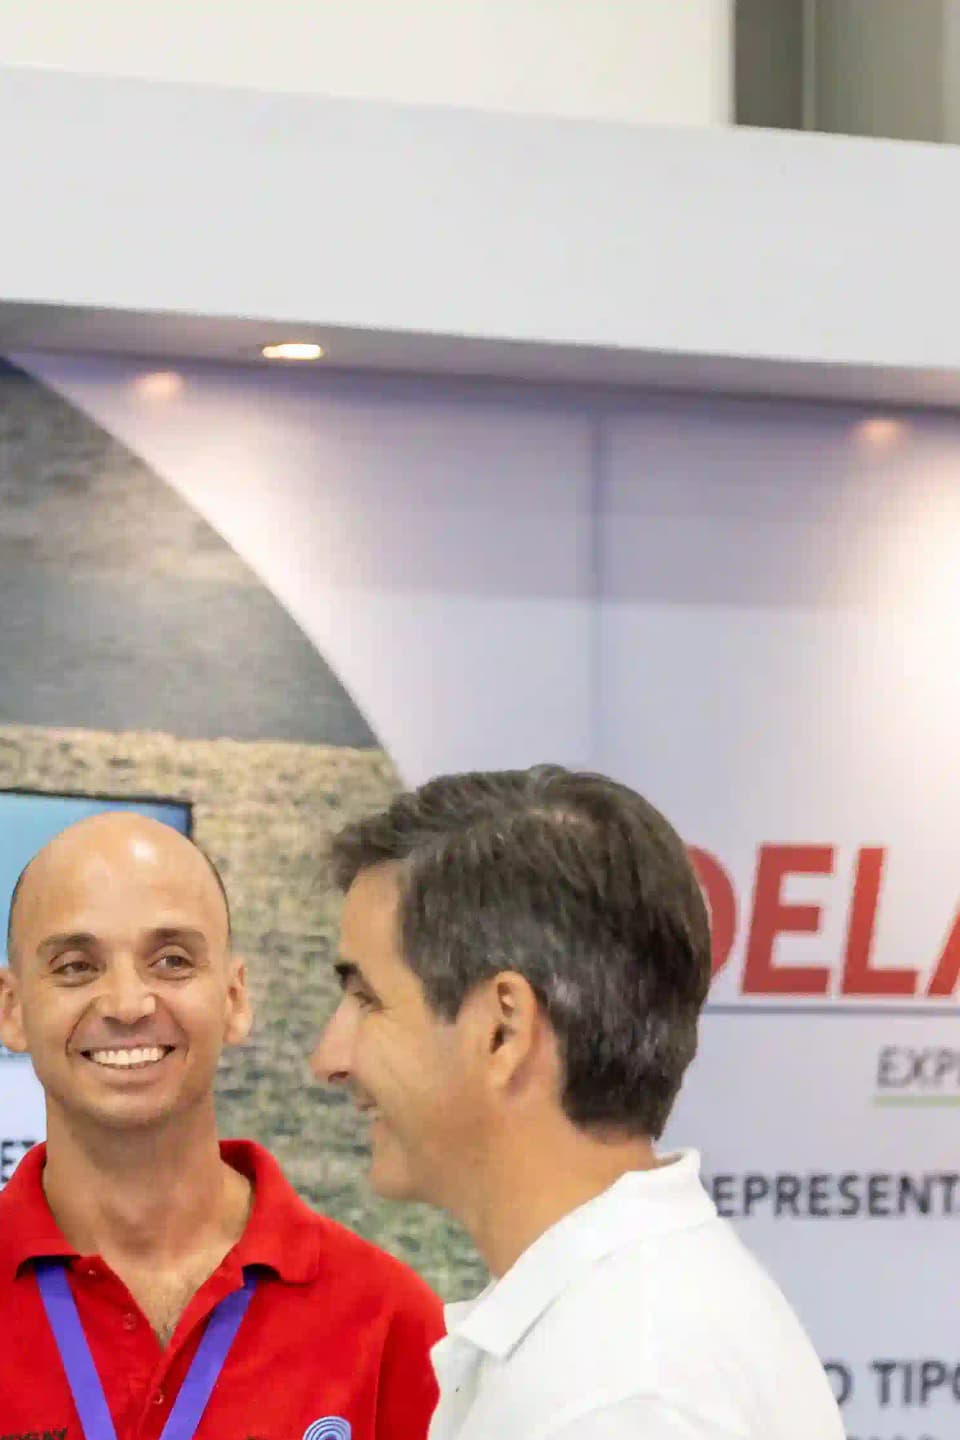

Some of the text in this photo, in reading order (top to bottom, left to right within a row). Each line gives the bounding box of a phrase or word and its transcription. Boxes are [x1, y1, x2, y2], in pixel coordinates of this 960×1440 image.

[876, 1045, 960, 1090] EXP
[710, 1172, 960, 1218] EPRESENT
[824, 1360, 960, 1405] O TIP
